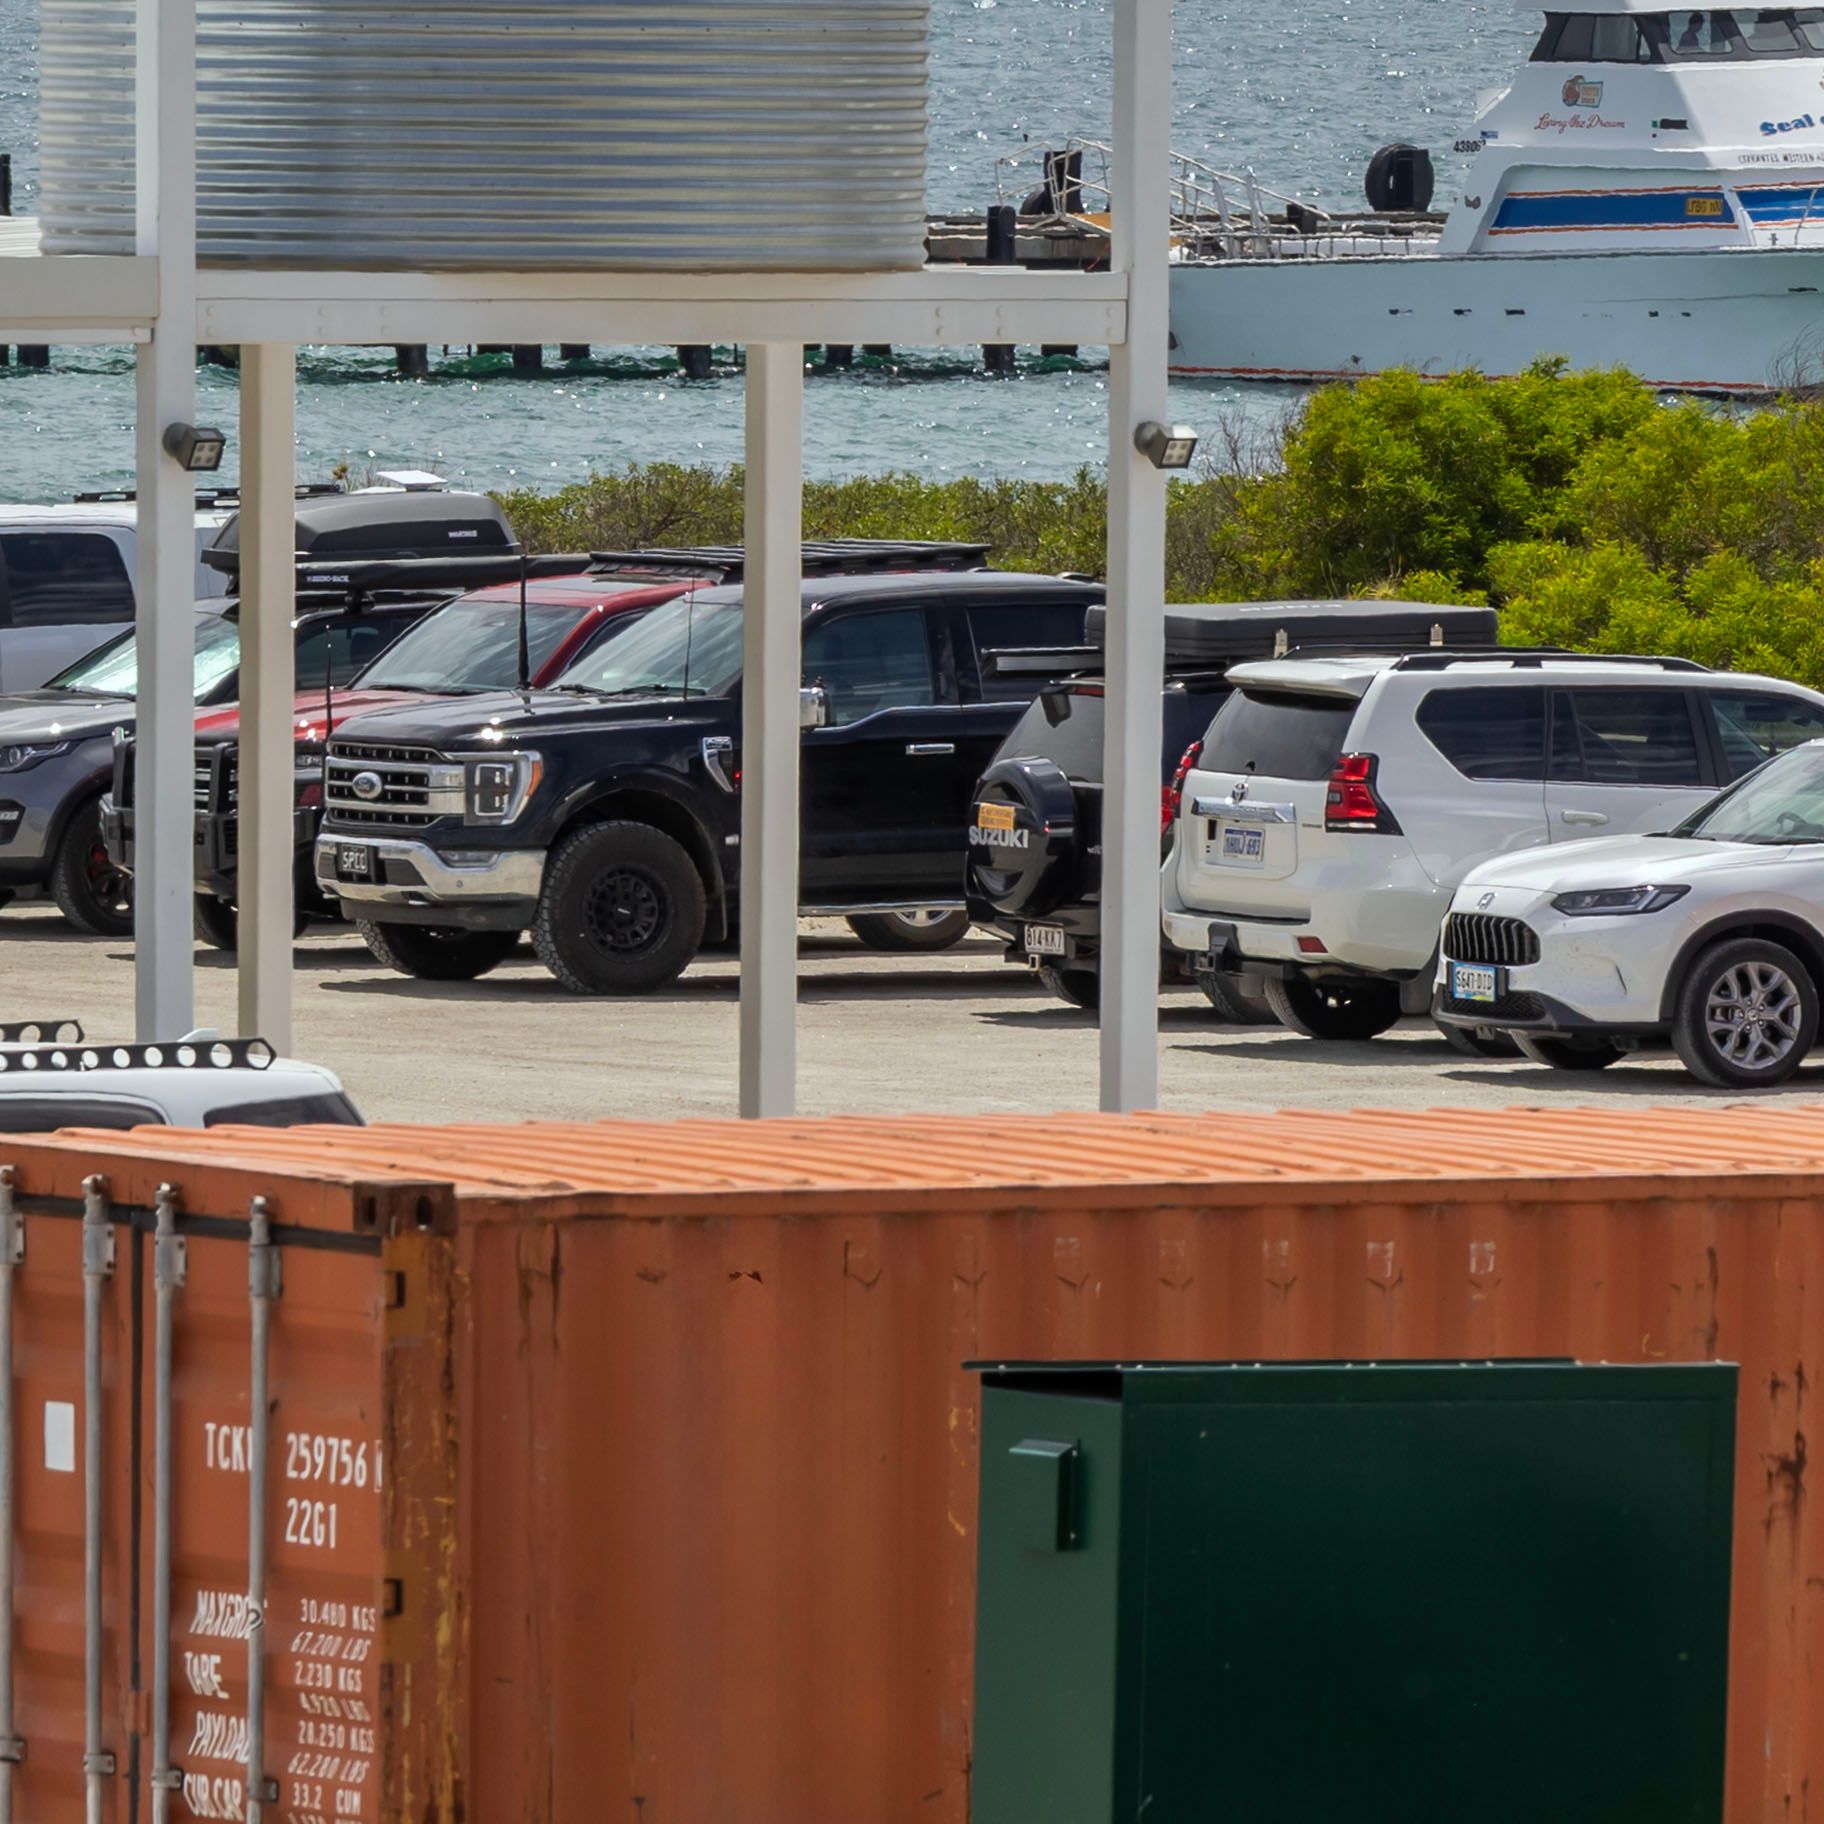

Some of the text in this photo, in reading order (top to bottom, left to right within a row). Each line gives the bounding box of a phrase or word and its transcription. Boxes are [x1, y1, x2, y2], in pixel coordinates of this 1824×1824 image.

[1759, 114, 1816, 136] Seal
[969, 825, 1029, 849] SUZUKI
[286, 1432, 368, 1488] 259756
[285, 1497, 337, 1549] 22G1
[352, 1605, 376, 1632] KGS
[341, 1637, 372, 1662] LBS
[338, 1666, 362, 1693] KGS
[350, 1727, 375, 1753] KGS
[340, 1759, 370, 1784] LBS
[336, 1789, 361, 1815] CUM
